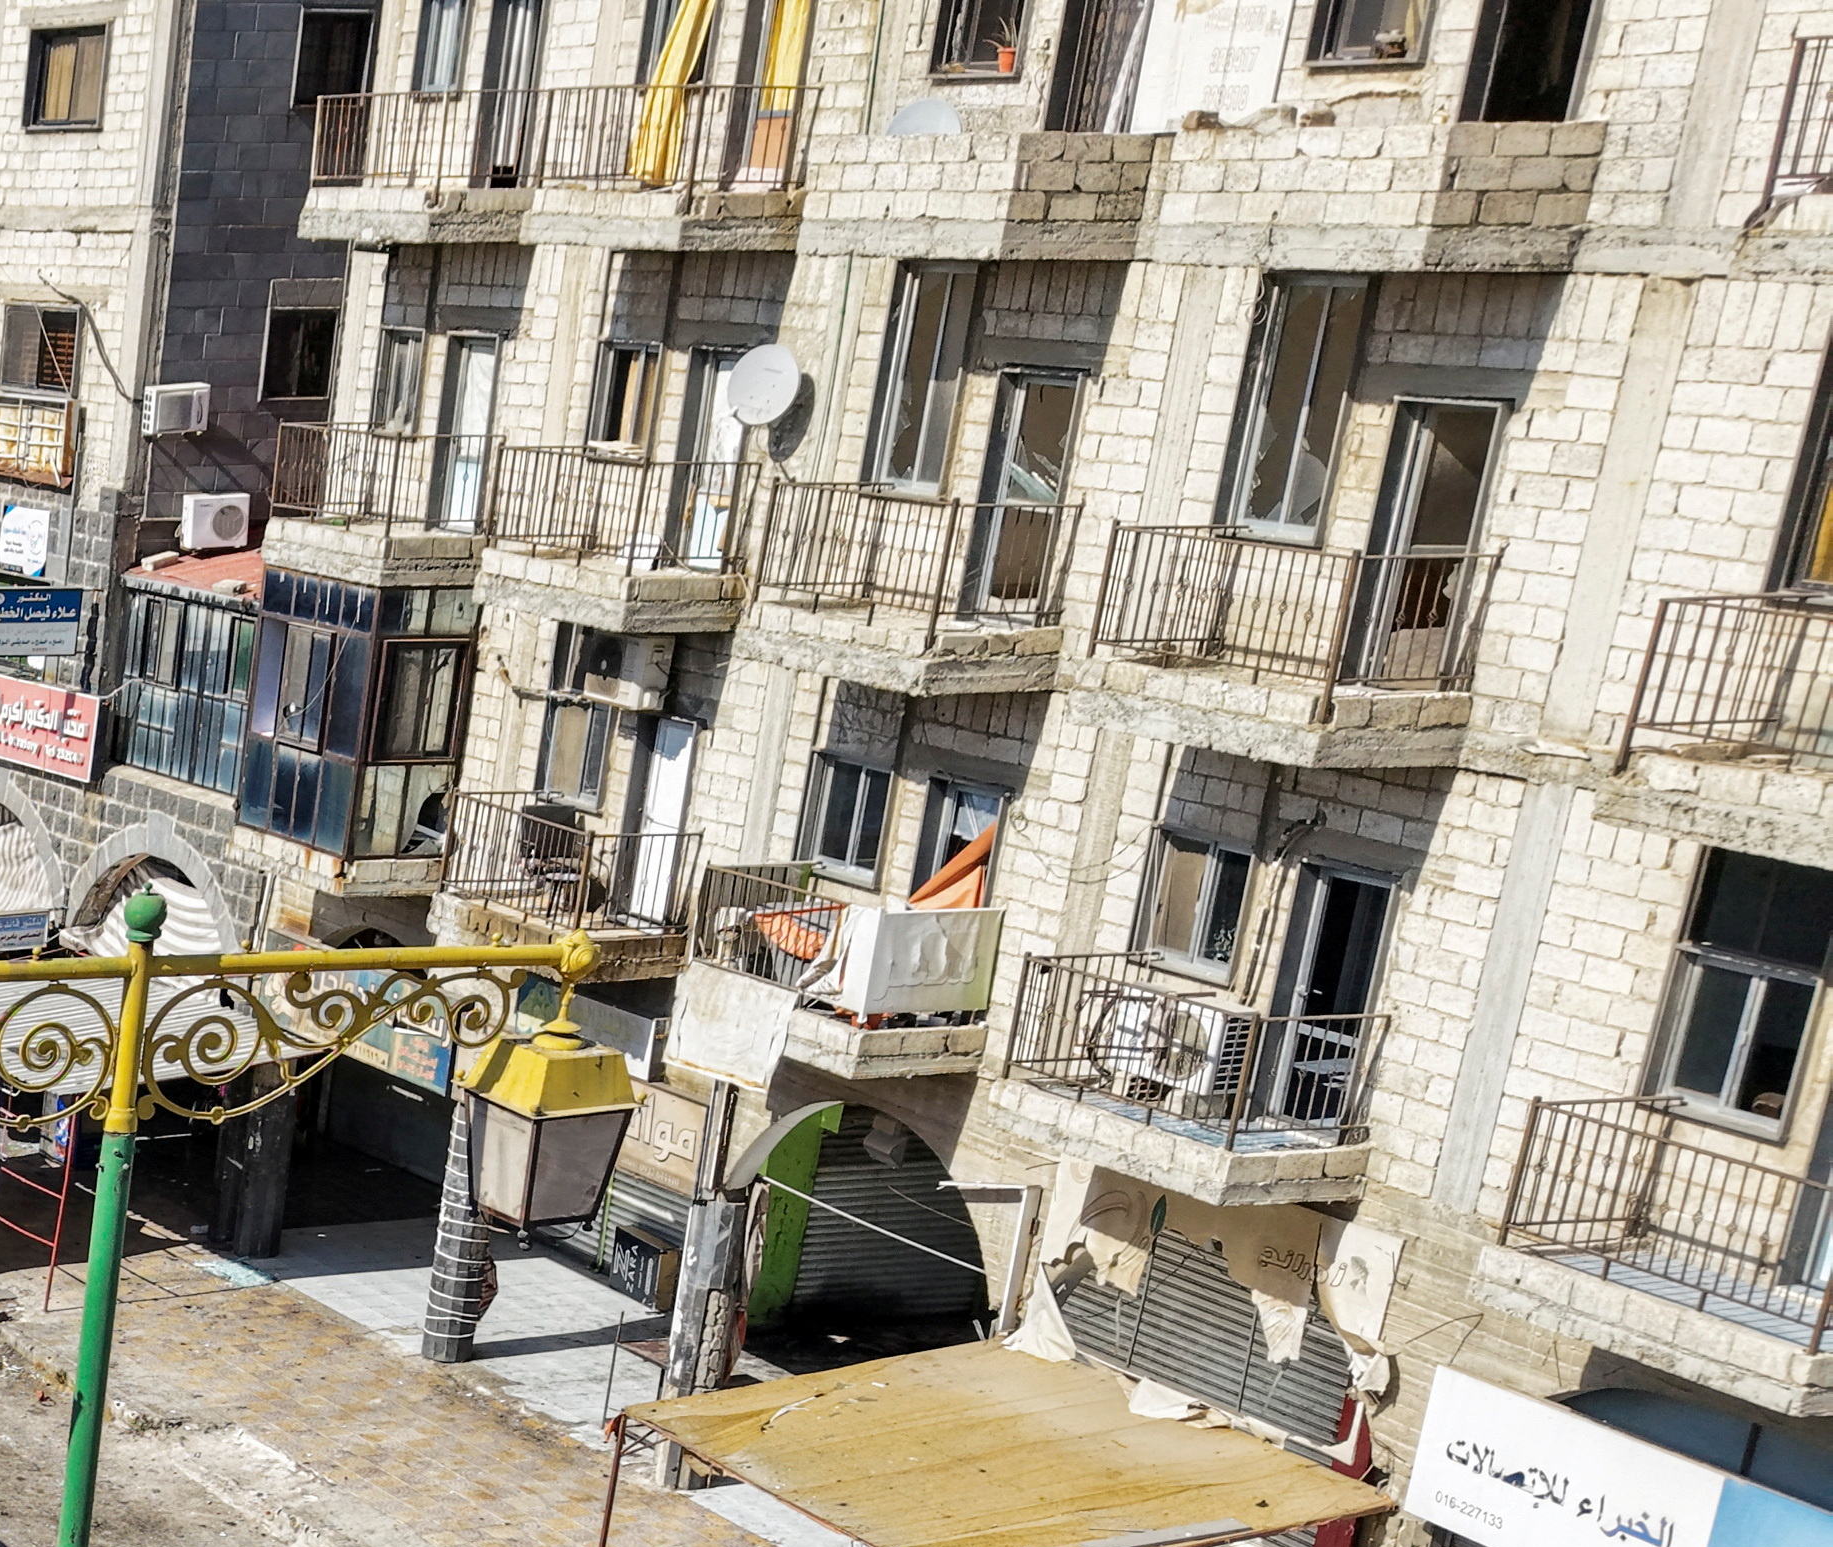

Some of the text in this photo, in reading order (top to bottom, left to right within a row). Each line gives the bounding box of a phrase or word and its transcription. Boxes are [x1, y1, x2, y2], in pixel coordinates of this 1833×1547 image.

[17, 592, 52, 604] الدكتور
[625, 1244, 639, 1293] ZARA
[1435, 1490, 1504, 1530] 016-227133
